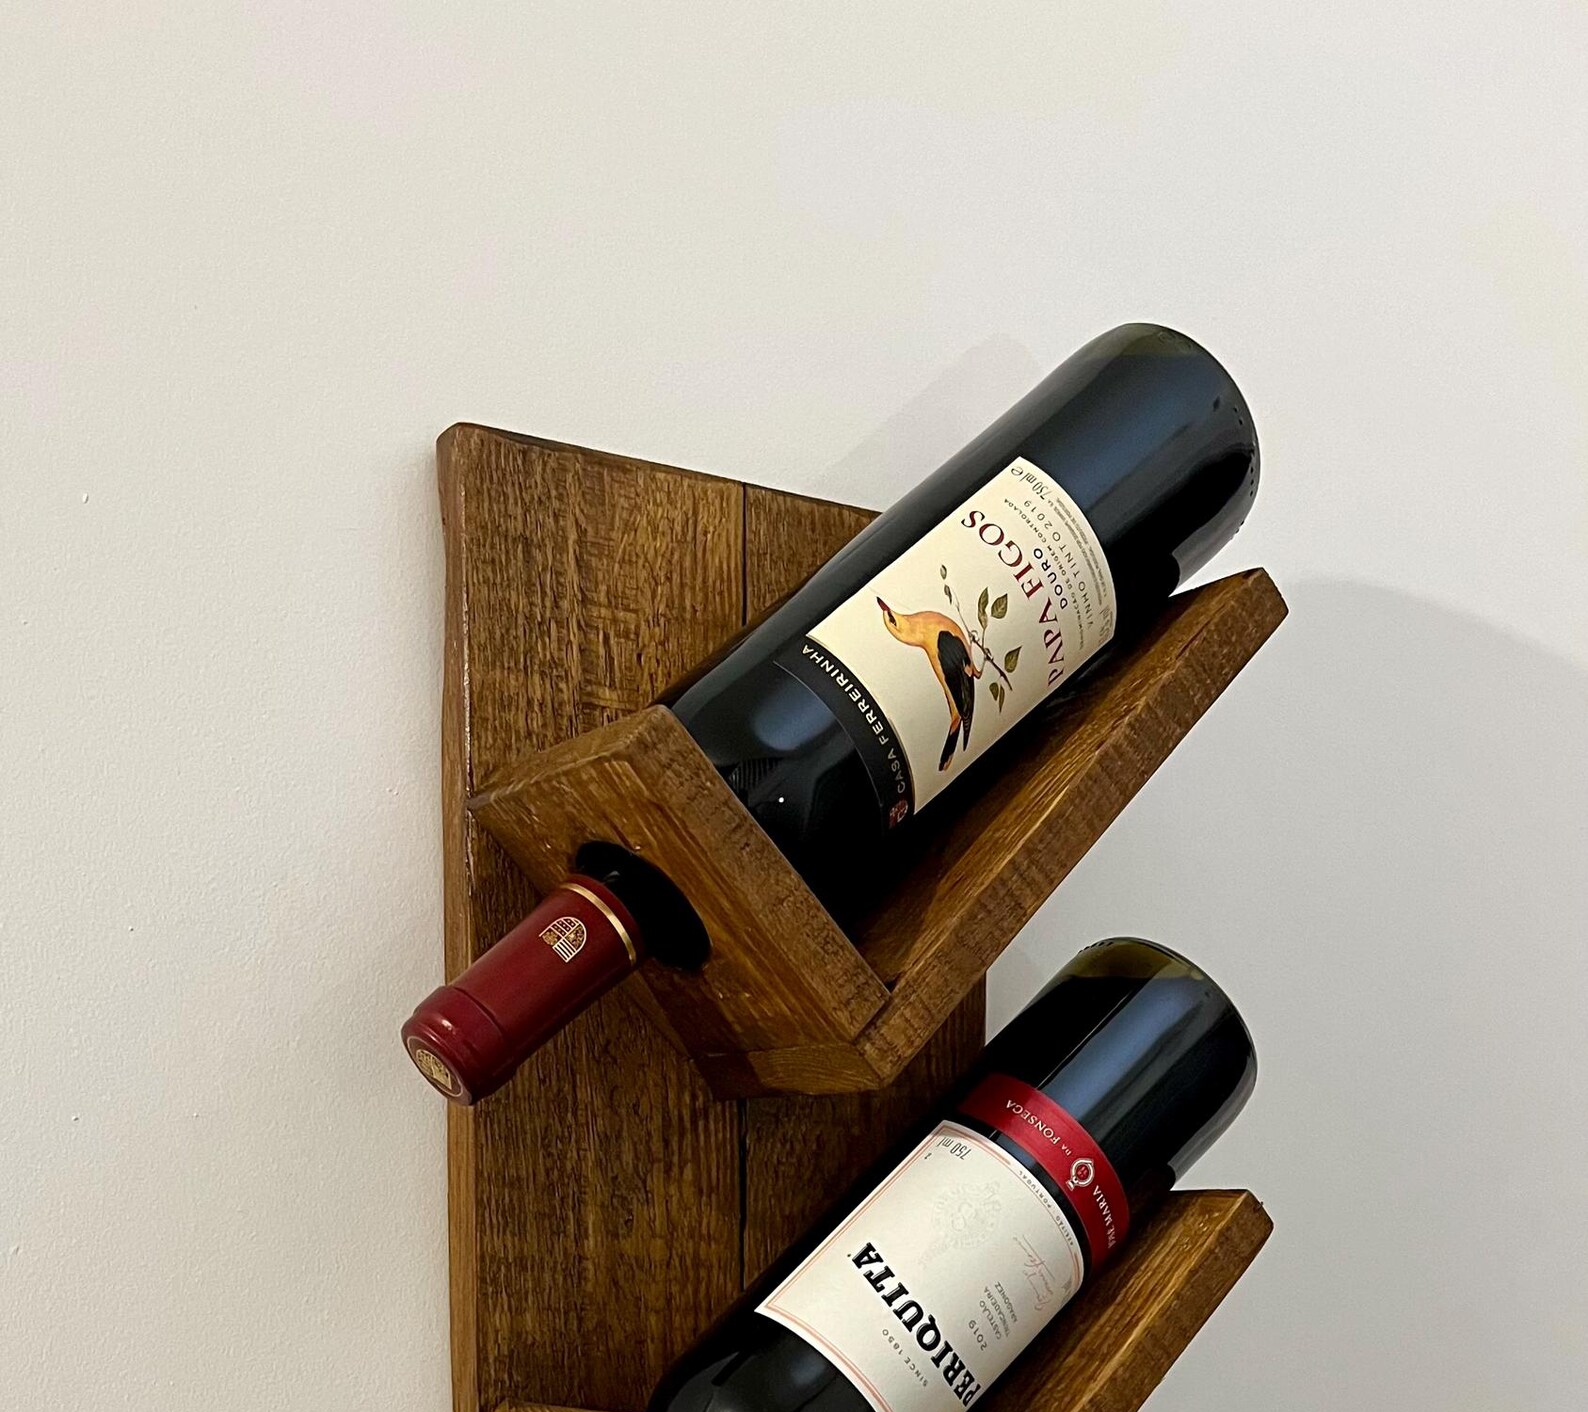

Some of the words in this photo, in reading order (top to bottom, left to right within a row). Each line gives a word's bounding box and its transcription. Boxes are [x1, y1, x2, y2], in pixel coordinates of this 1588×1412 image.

[1031, 481, 1053, 501] 750
[1004, 498, 1047, 544] CONTROLADA
[1023, 500, 1053, 530] 2019
[960, 510, 1045, 600] FIGOS
[1047, 545, 1067, 576] ORIGEM
[1052, 531, 1080, 578] TINTO
[1033, 548, 1069, 610] DOURO
[1077, 581, 1094, 629] VINHO
[1037, 596, 1066, 689] PAPA
[802, 644, 889, 745] FERREIRINHA
[887, 748, 905, 794] CASA
[1006, 1099, 1061, 1145] FONSECA
[949, 1142, 972, 1160] 750
[1061, 1144, 1072, 1156] DA
[1019, 1170, 1052, 1208] PORTUGAL
[1092, 1185, 1114, 1224] MARIA
[852, 1242, 981, 1407] PERIQUITA
[968, 1320, 988, 1351] 2019
[979, 1300, 1002, 1340] CASTELÃO
[882, 1329, 903, 1355] 1850
[904, 1357, 930, 1388] SINCE
